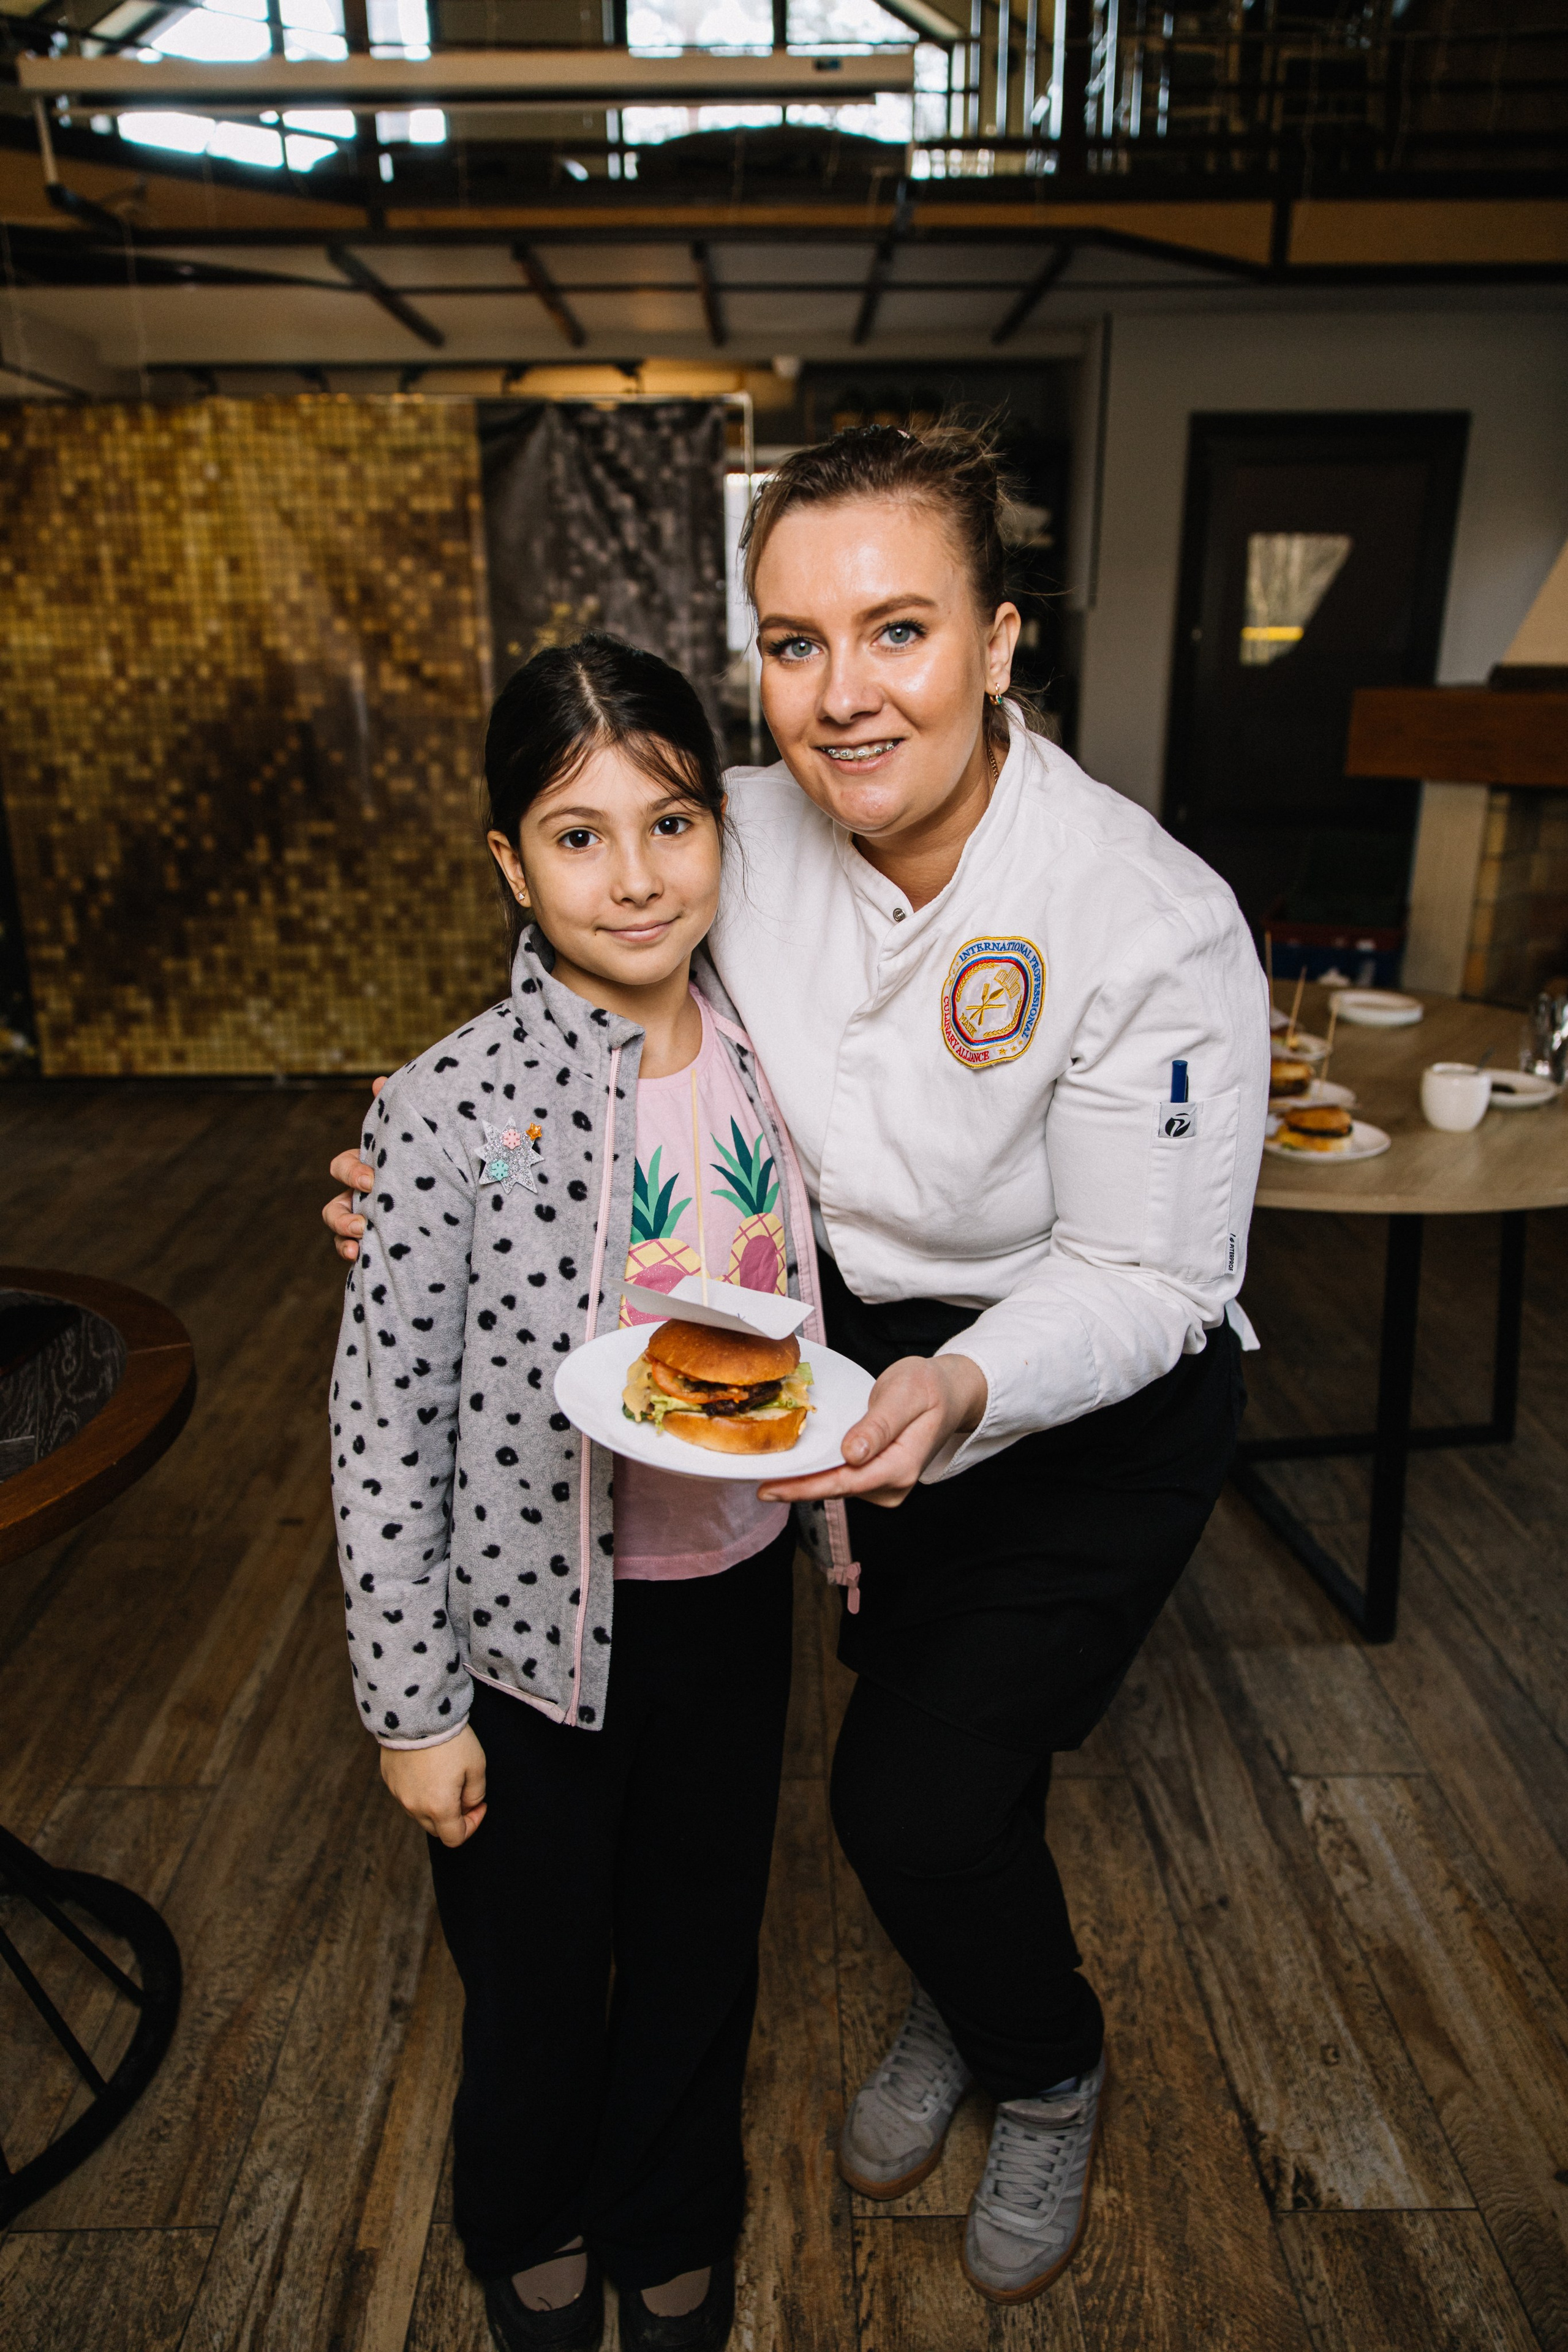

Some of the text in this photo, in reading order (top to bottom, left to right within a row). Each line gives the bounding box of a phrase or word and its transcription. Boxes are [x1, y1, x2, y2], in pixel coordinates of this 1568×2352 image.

[943, 996, 990, 1063] CULINARY ALLIANCE
[959, 942, 1041, 1038] INTERNATIONAL PROFESSIONAL
